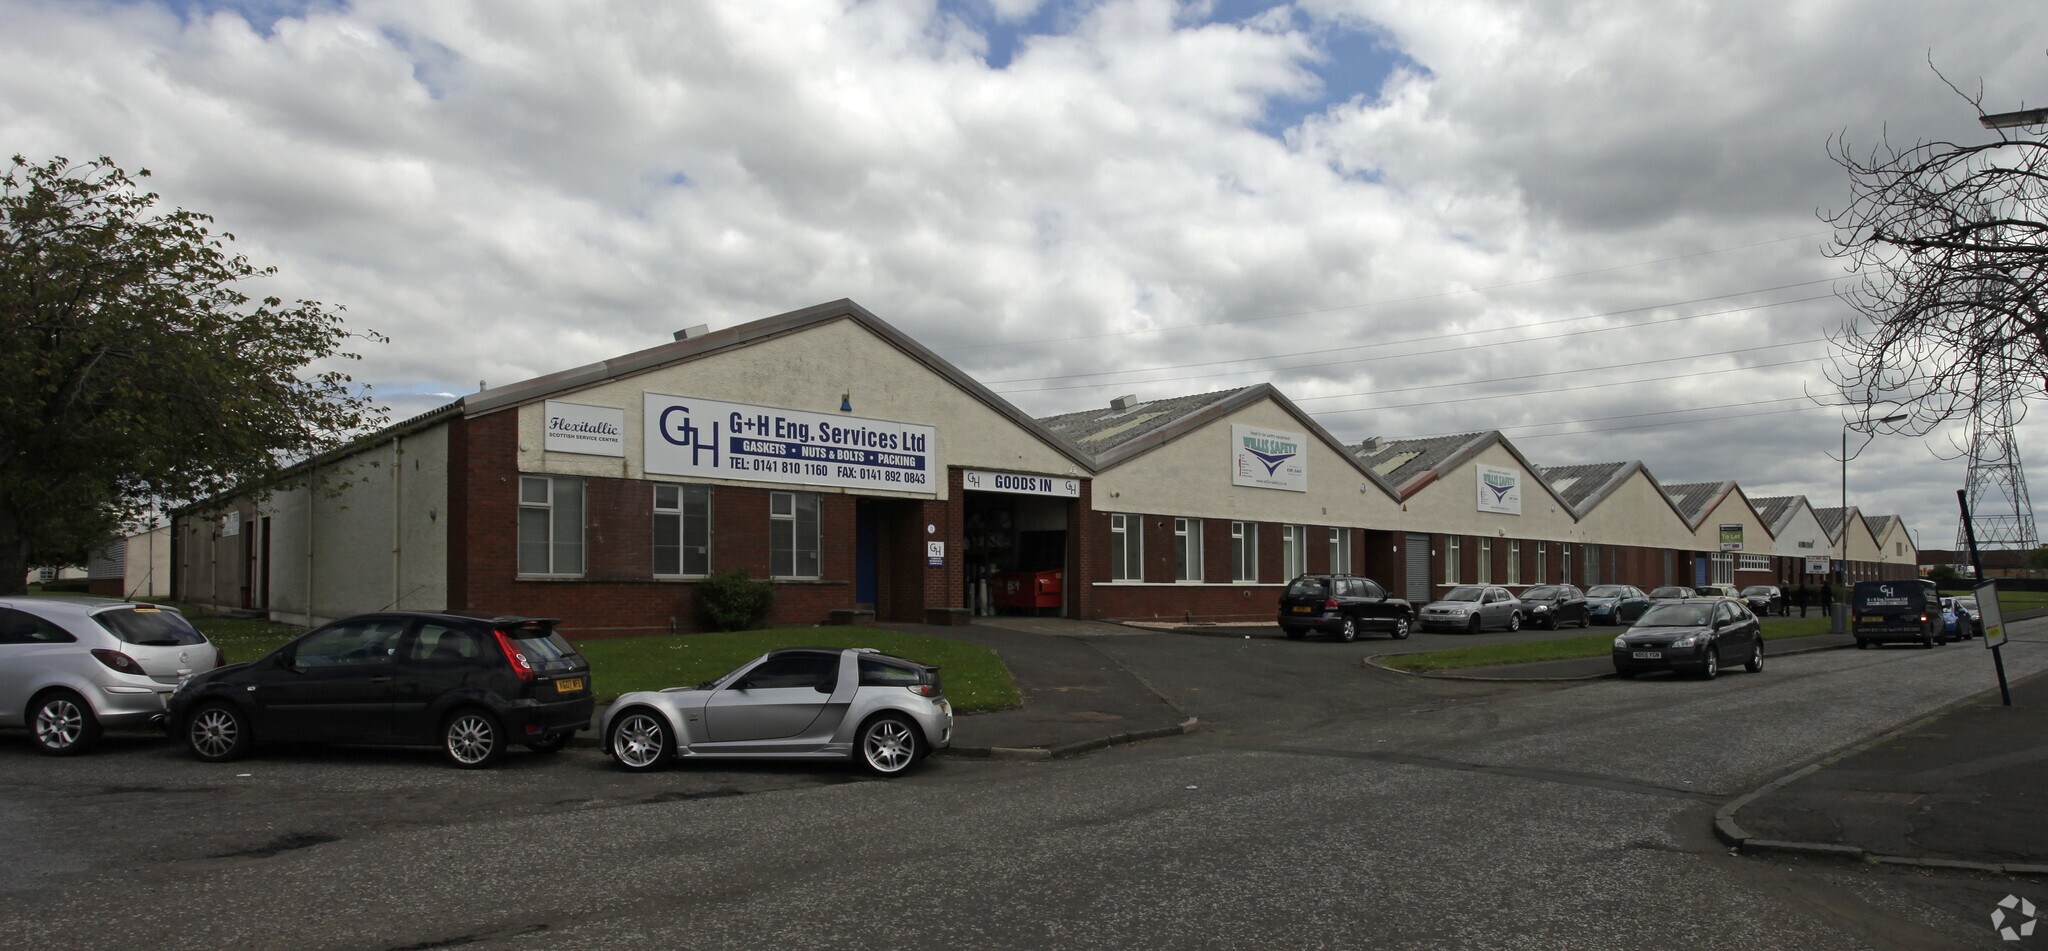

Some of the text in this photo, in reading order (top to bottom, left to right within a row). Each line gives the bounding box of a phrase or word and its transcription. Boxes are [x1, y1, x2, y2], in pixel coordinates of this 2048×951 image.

[549, 417, 618, 435] Flexitallic
[729, 411, 926, 453] G+H Eng. Services Ltd
[742, 440, 916, 467] GASKETS NUTS & BOLTS PACKING
[1243, 436, 1297, 454] WILLIS SAFETY
[729, 456, 828, 477] TEL: 0141 810 1160
[837, 466, 926, 485] FAX: 0141 892 0843
[995, 474, 1052, 493] GOODS IN
